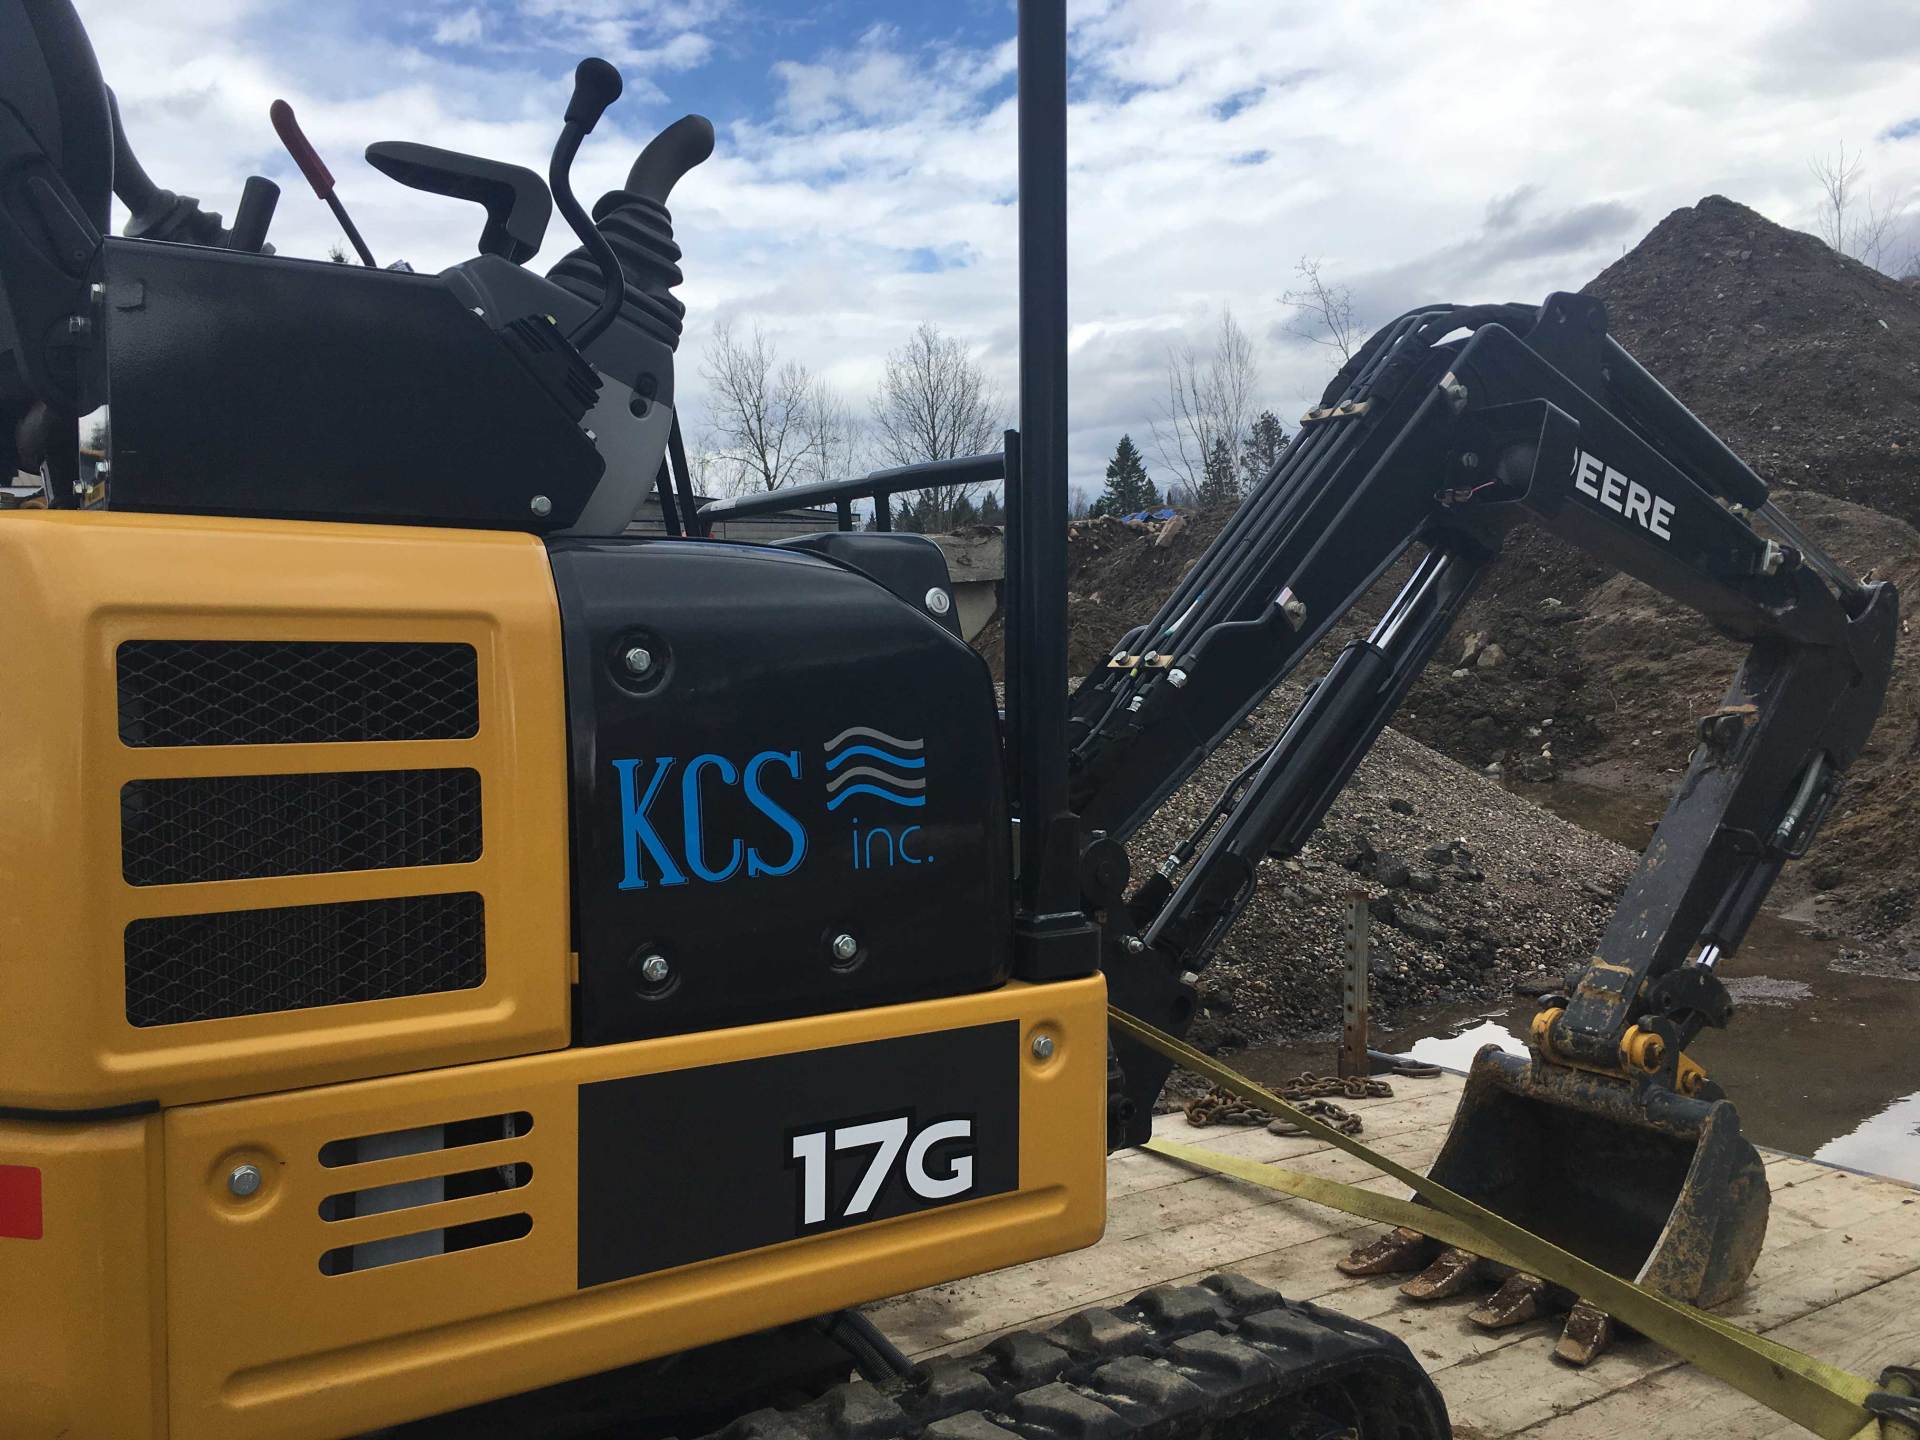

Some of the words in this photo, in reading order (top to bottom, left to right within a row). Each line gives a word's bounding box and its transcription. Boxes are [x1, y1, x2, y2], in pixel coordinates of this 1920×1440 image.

[1570, 447, 1676, 541] EERE
[612, 751, 808, 890] KCS
[853, 817, 935, 869] inc.
[792, 1116, 973, 1225] 17G
